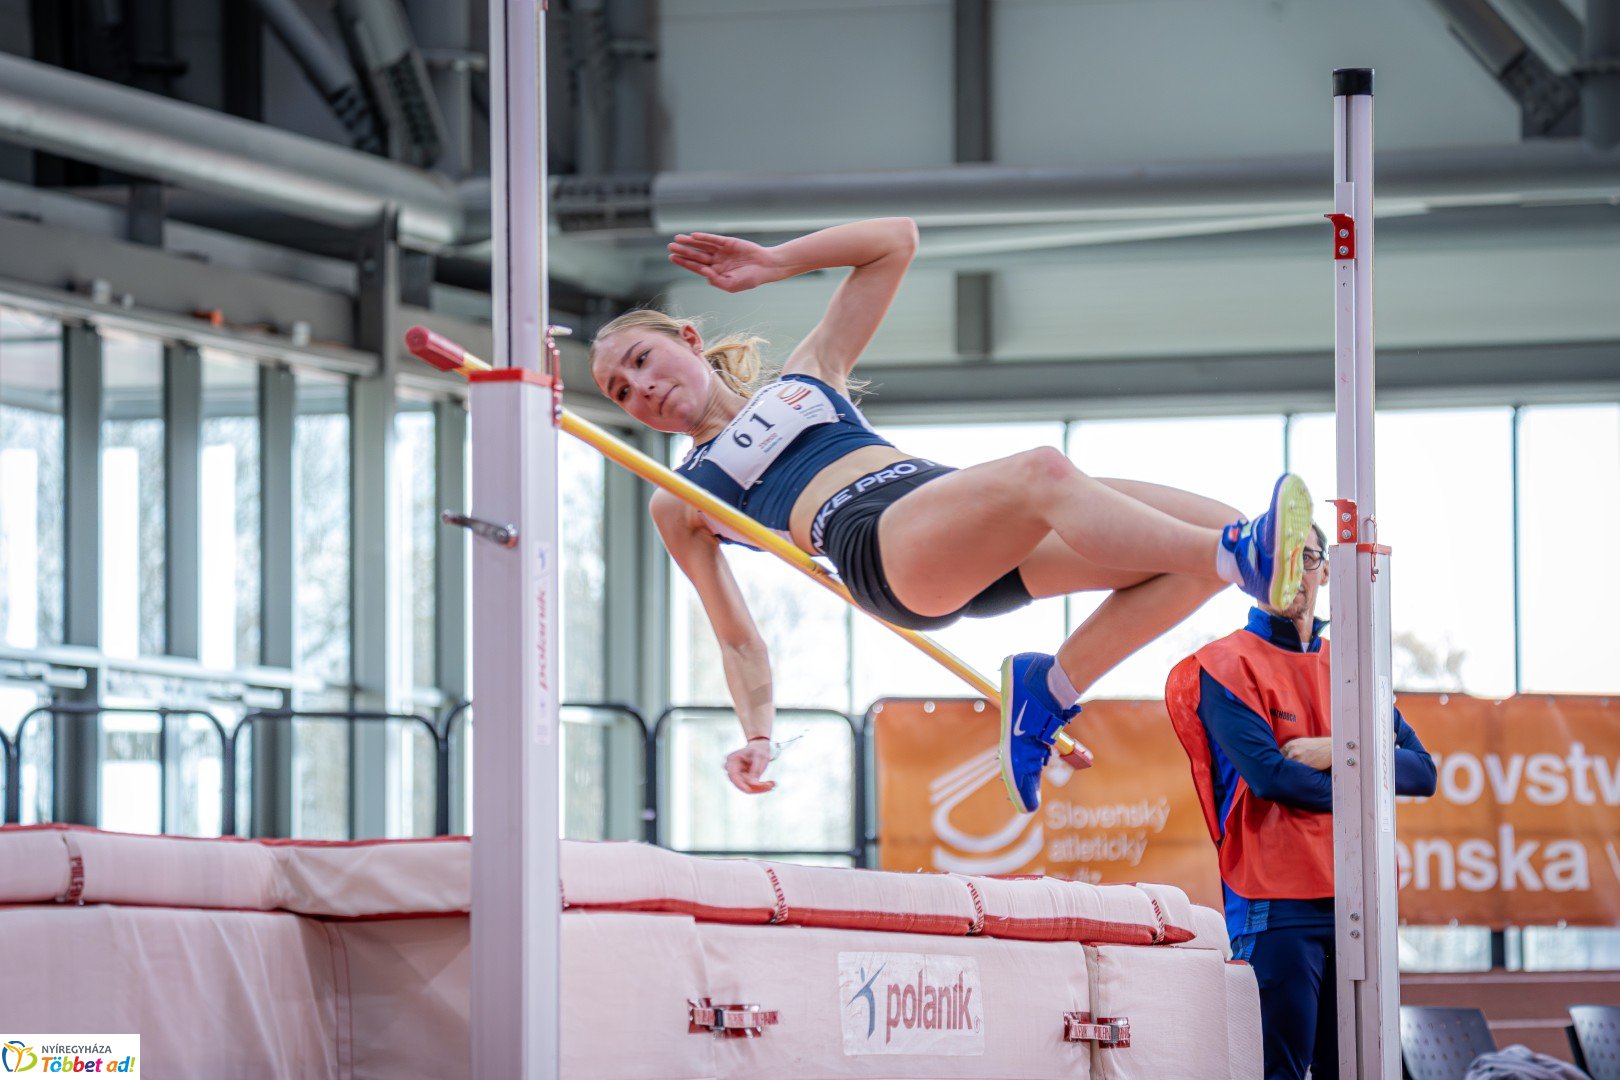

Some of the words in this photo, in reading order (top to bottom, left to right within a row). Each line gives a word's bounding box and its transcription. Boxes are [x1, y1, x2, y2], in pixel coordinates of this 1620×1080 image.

[732, 411, 776, 449] 61
[855, 462, 918, 493] PRO
[1396, 741, 1620, 806] ovstv
[1045, 796, 1170, 834] Slovenský
[1049, 830, 1148, 867] atletický
[886, 968, 973, 1045] polanik
